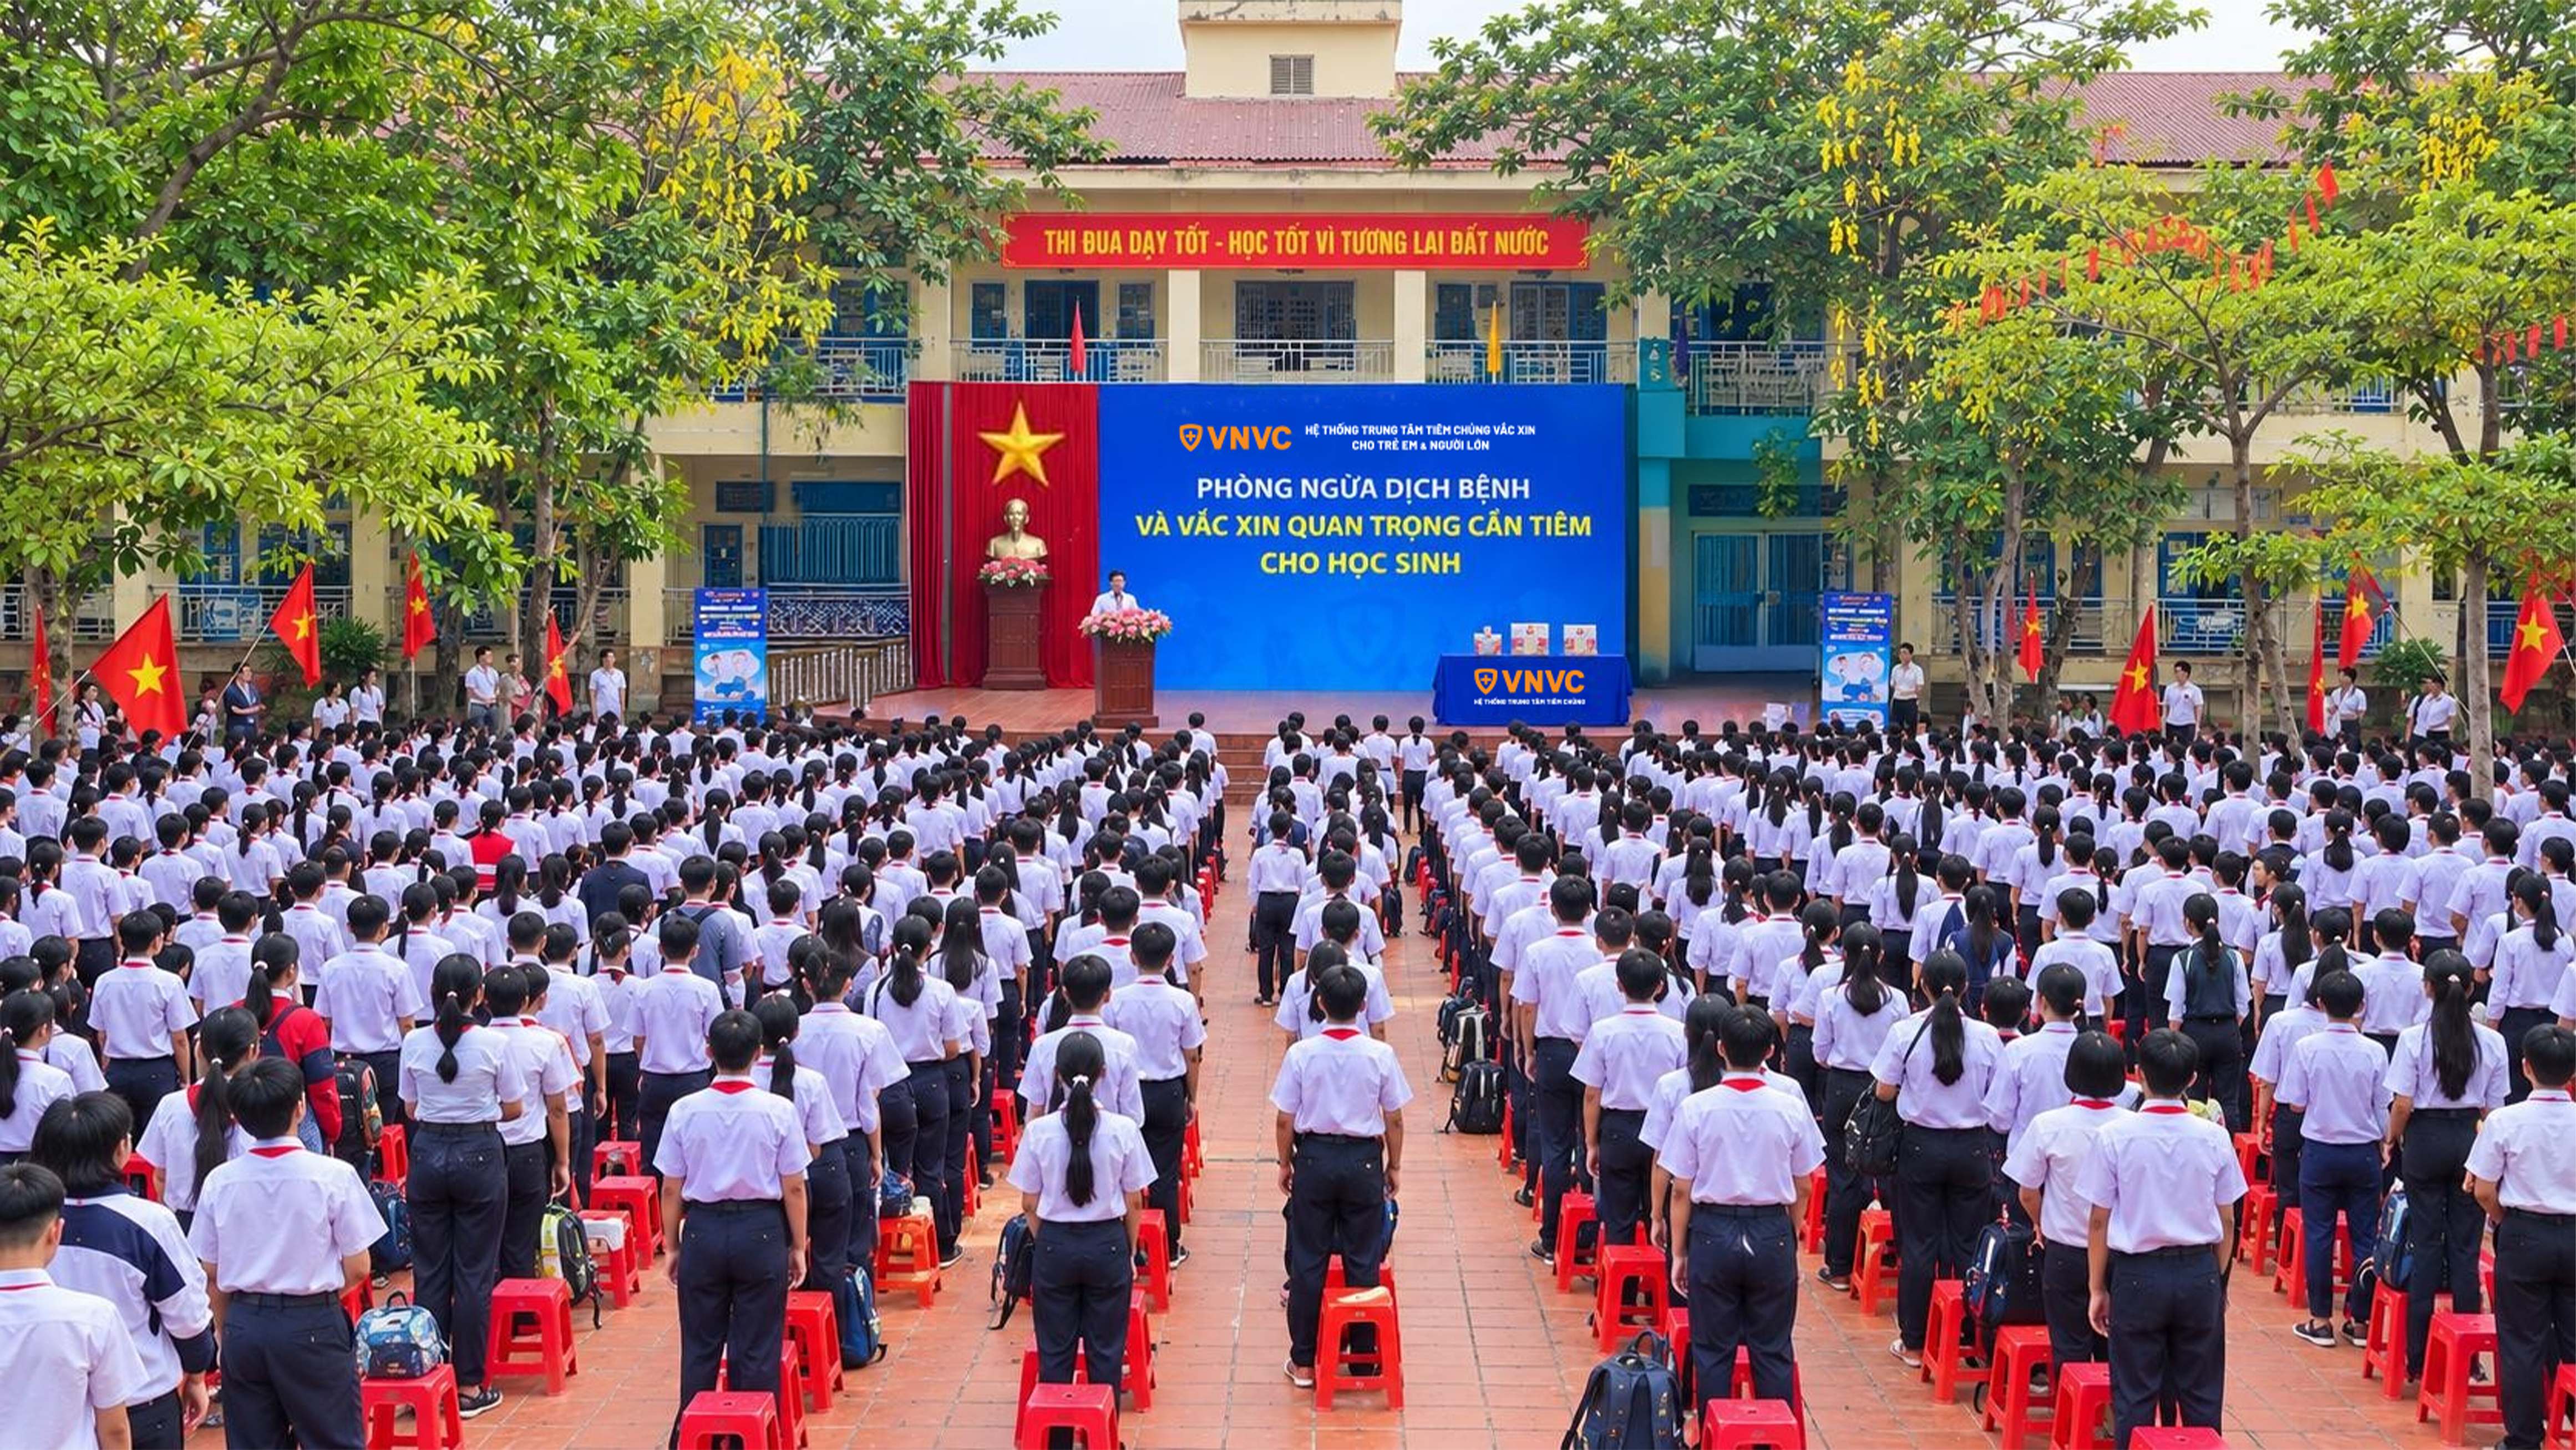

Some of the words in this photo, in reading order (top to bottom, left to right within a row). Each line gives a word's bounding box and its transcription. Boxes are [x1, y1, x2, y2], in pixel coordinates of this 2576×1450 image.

[1044, 230, 1076, 254] THI
[1082, 230, 1122, 255] ĐUA
[1129, 230, 1167, 260] DẠY
[1174, 222, 1209, 255] TỐT
[1229, 230, 1268, 260] HỌC
[1274, 222, 1310, 255] TỐT
[1315, 225, 1334, 254] VÌ
[1341, 227, 1407, 255] TƯƠNG
[1413, 230, 1443, 255] LAI
[1451, 222, 1488, 255] ĐẤT
[1495, 224, 1549, 255] NƯỚC
[1207, 425, 1292, 450] VNVC
[1305, 423, 1320, 438] HỆ
[1322, 422, 1359, 435] THỐNG
[1361, 424, 1398, 435] TRUNG
[1400, 423, 1423, 435] TÂM
[1426, 423, 1451, 435] TIÊM
[1453, 422, 1490, 435] CHỦNG
[1493, 422, 1515, 435] VẮC
[1517, 425, 1535, 435] XIN
[1352, 440, 1375, 451] CHO
[1377, 437, 1399, 451] TRẺ
[1402, 440, 1418, 451] EM
[1420, 442, 1427, 450] &
[1429, 438, 1464, 451] NGƯỜI
[1467, 438, 1490, 451] LỚN
[1198, 473, 1292, 499] PHÒNG
[1301, 473, 1377, 499] NGỪA
[1386, 478, 1449, 505] DỊCH
[1459, 473, 1529, 505] BỆNH
[1135, 510, 1170, 536] VÀ
[1178, 508, 1228, 536] VẮC
[1236, 515, 1280, 536] XIN
[1287, 515, 1362, 539] QUAN
[1370, 515, 1461, 542] TRỌNG
[1468, 508, 1522, 536] CẦN
[1529, 510, 1591, 536] TIÊM
[1261, 552, 1320, 574] CHO
[1328, 552, 1387, 579] HỌC
[1396, 552, 1460, 574] SINH
[1502, 670, 1585, 693] VNVC
